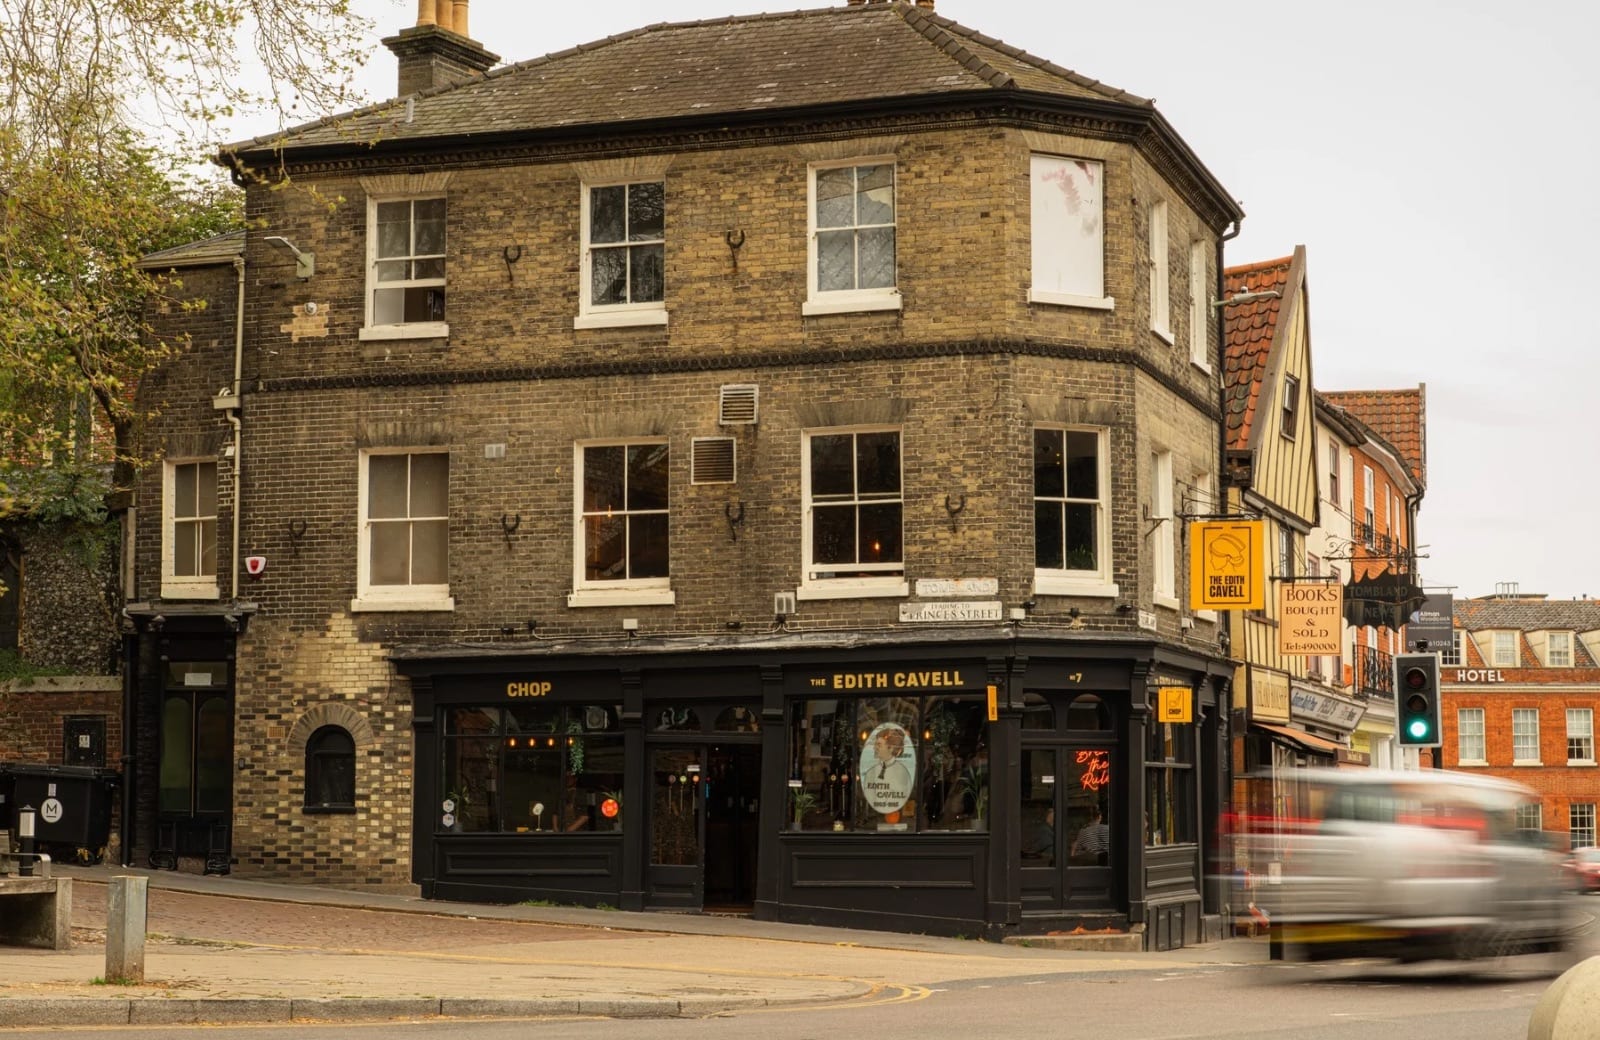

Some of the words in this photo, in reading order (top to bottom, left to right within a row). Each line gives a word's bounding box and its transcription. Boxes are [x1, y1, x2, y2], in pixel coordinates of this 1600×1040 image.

[1209, 575, 1223, 585] THE
[1224, 575, 1245, 585] EDITH
[1209, 585, 1245, 598] CAVELL
[1286, 588, 1338, 602] BOOKS
[1348, 585, 1408, 598] TOMBLAND
[960, 609, 999, 619] STREET
[1285, 606, 1338, 616] BOUGHT
[1305, 617, 1316, 627] &
[1292, 629, 1329, 638] SOLD
[1284, 642, 1337, 651] Tel:490000
[810, 678, 826, 687] THE
[833, 673, 888, 690] EDITH
[893, 670, 964, 687] CAVELL
[1457, 669, 1505, 682] HOTEL
[507, 681, 552, 697] CHOP
[867, 782, 890, 790] EDITH
[876, 791, 906, 799] CAVELL
